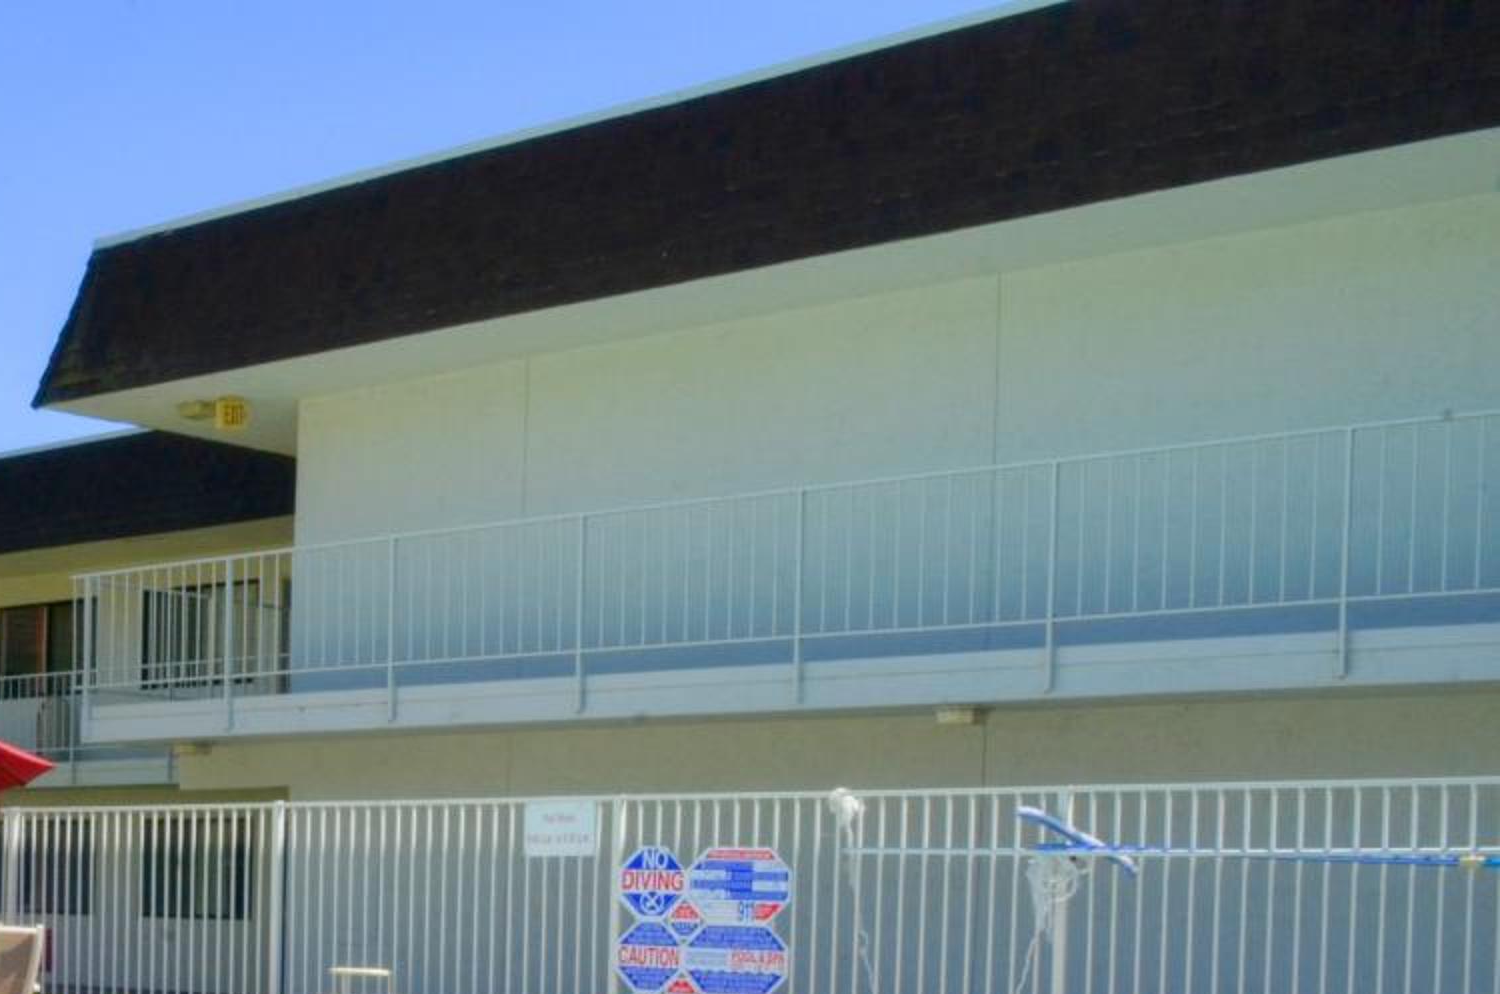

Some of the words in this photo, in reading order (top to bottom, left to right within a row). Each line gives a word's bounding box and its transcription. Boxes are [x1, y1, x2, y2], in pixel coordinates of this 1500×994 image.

[642, 849, 668, 869] NO
[621, 869, 684, 890] DIVING
[618, 946, 679, 967] CAUTION
